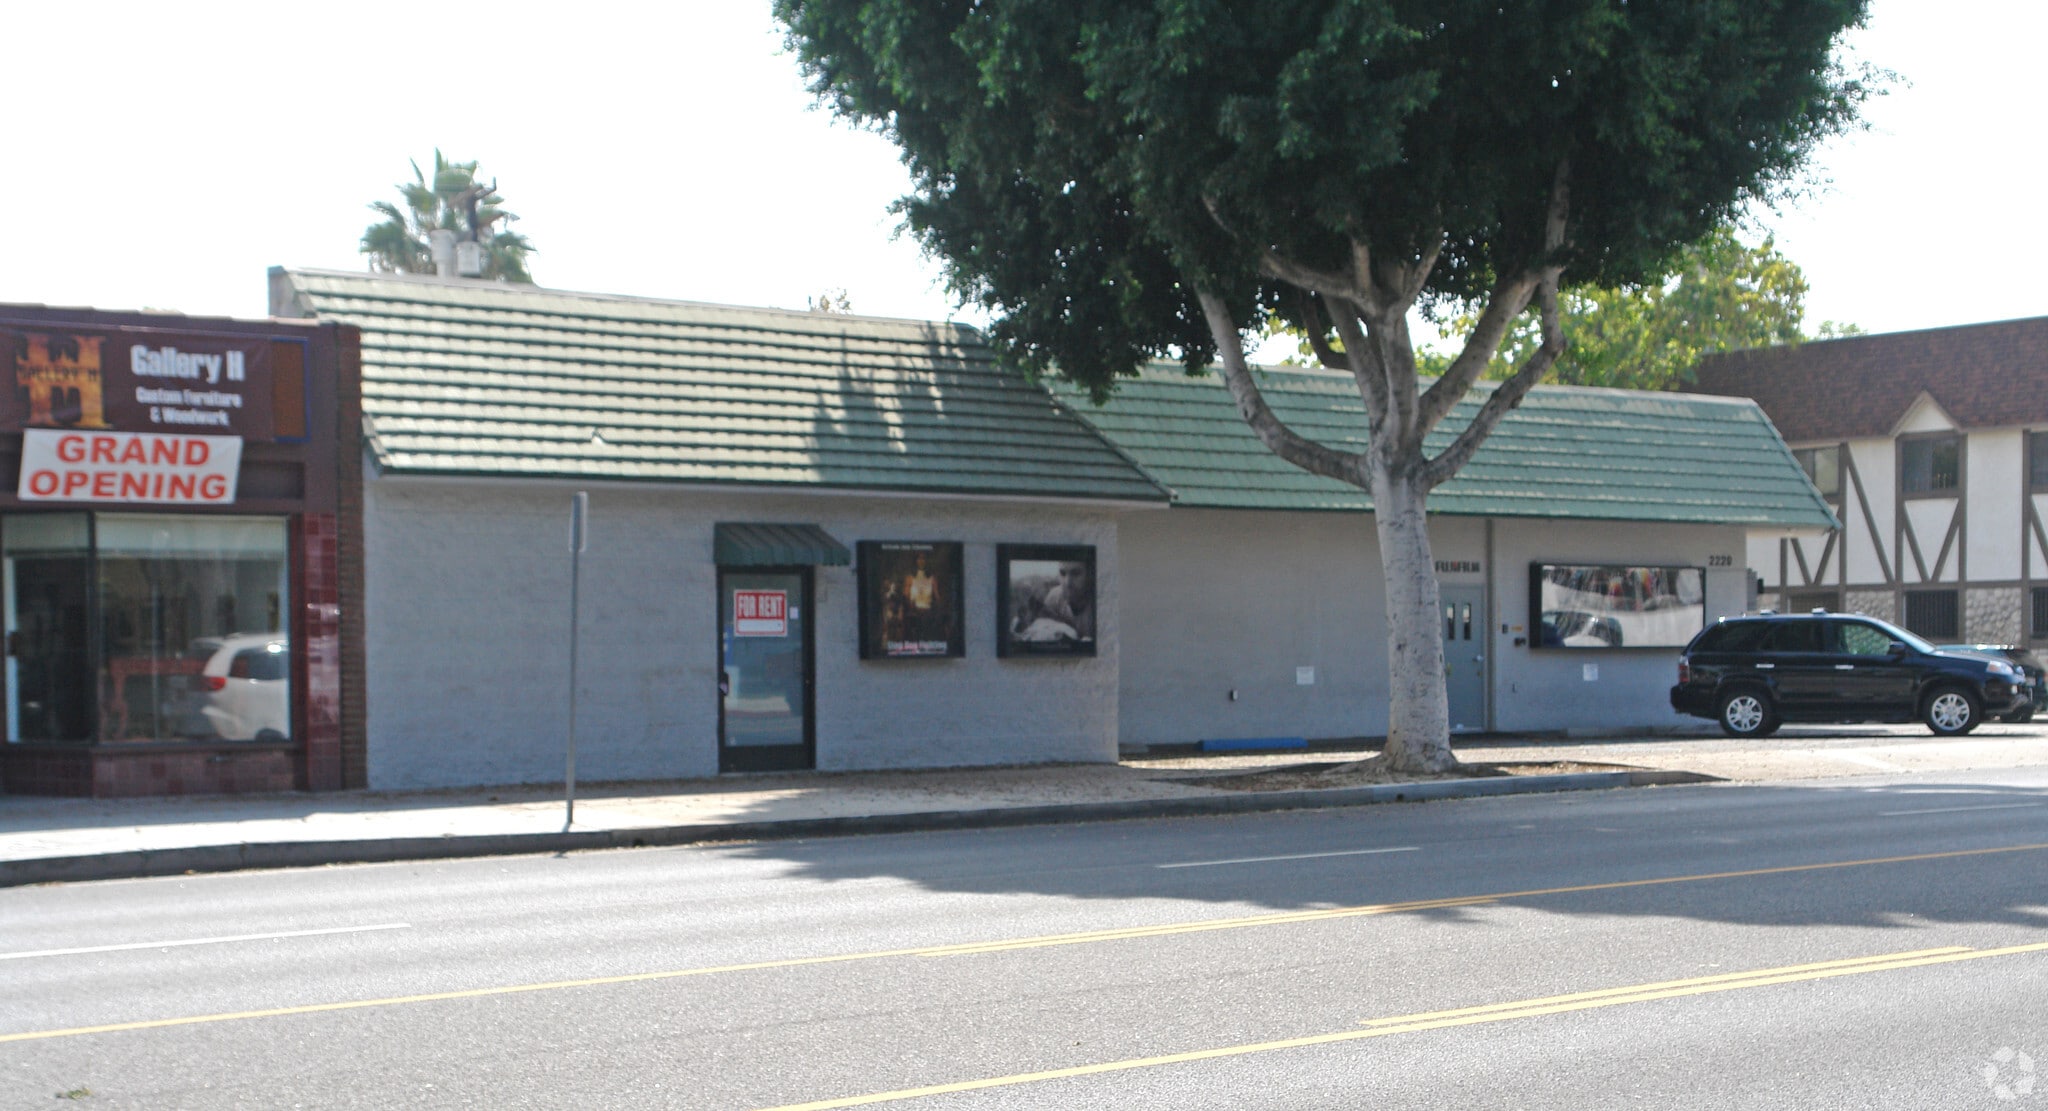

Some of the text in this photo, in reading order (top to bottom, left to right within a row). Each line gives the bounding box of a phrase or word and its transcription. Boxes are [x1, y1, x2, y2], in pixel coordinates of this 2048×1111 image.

[130, 344, 246, 384] Gallery H
[135, 386, 243, 408] Custom Furniture
[161, 406, 230, 426] Woodwork
[56, 435, 210, 466] GRAND
[29, 470, 226, 501] OPENING
[1435, 560, 1480, 573] FUJIFILM
[1709, 555, 1732, 567] 2220
[738, 594, 783, 617] FOR RENT
